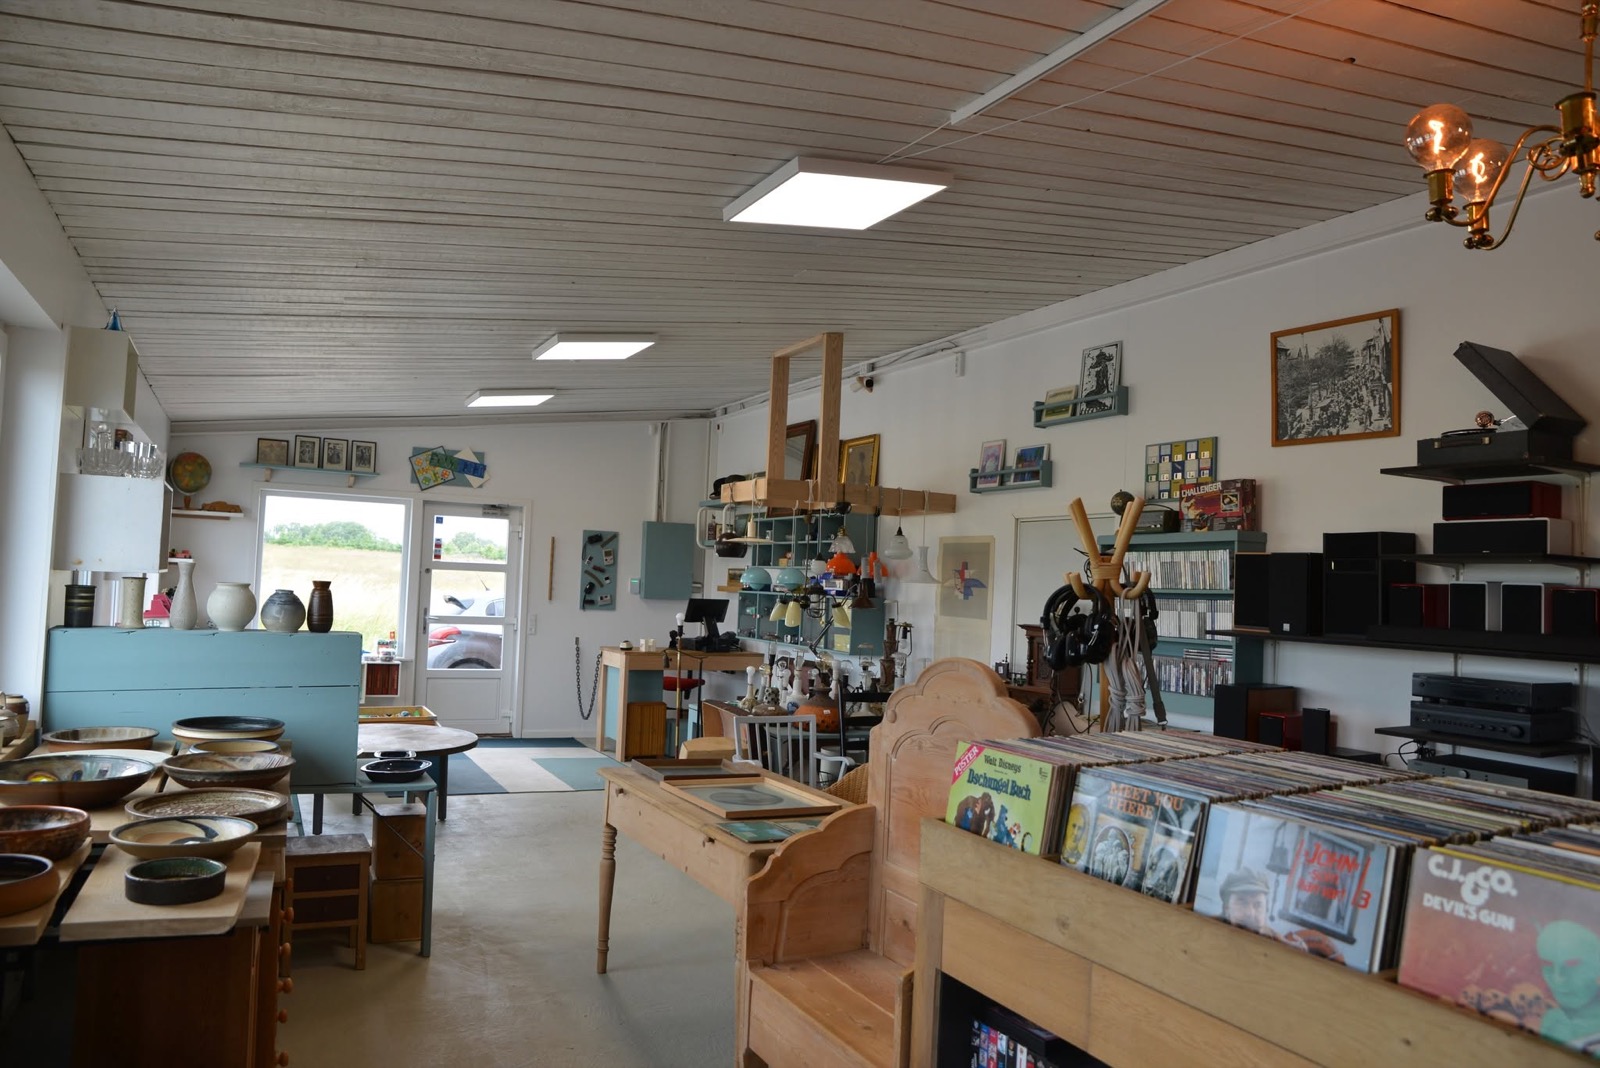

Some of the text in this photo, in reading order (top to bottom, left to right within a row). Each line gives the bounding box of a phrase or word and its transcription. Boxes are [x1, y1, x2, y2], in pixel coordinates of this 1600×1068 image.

[1181, 482, 1222, 497] CHALLENGER
[954, 745, 979, 776] POSTER
[984, 754, 997, 767] Walt
[967, 768, 1010, 795] Dschungel
[1009, 779, 1031, 801] Buch
[1109, 781, 1184, 811] MEET YOU
[1107, 795, 1155, 820] THERE
[1478, 908, 1517, 932] GUN
